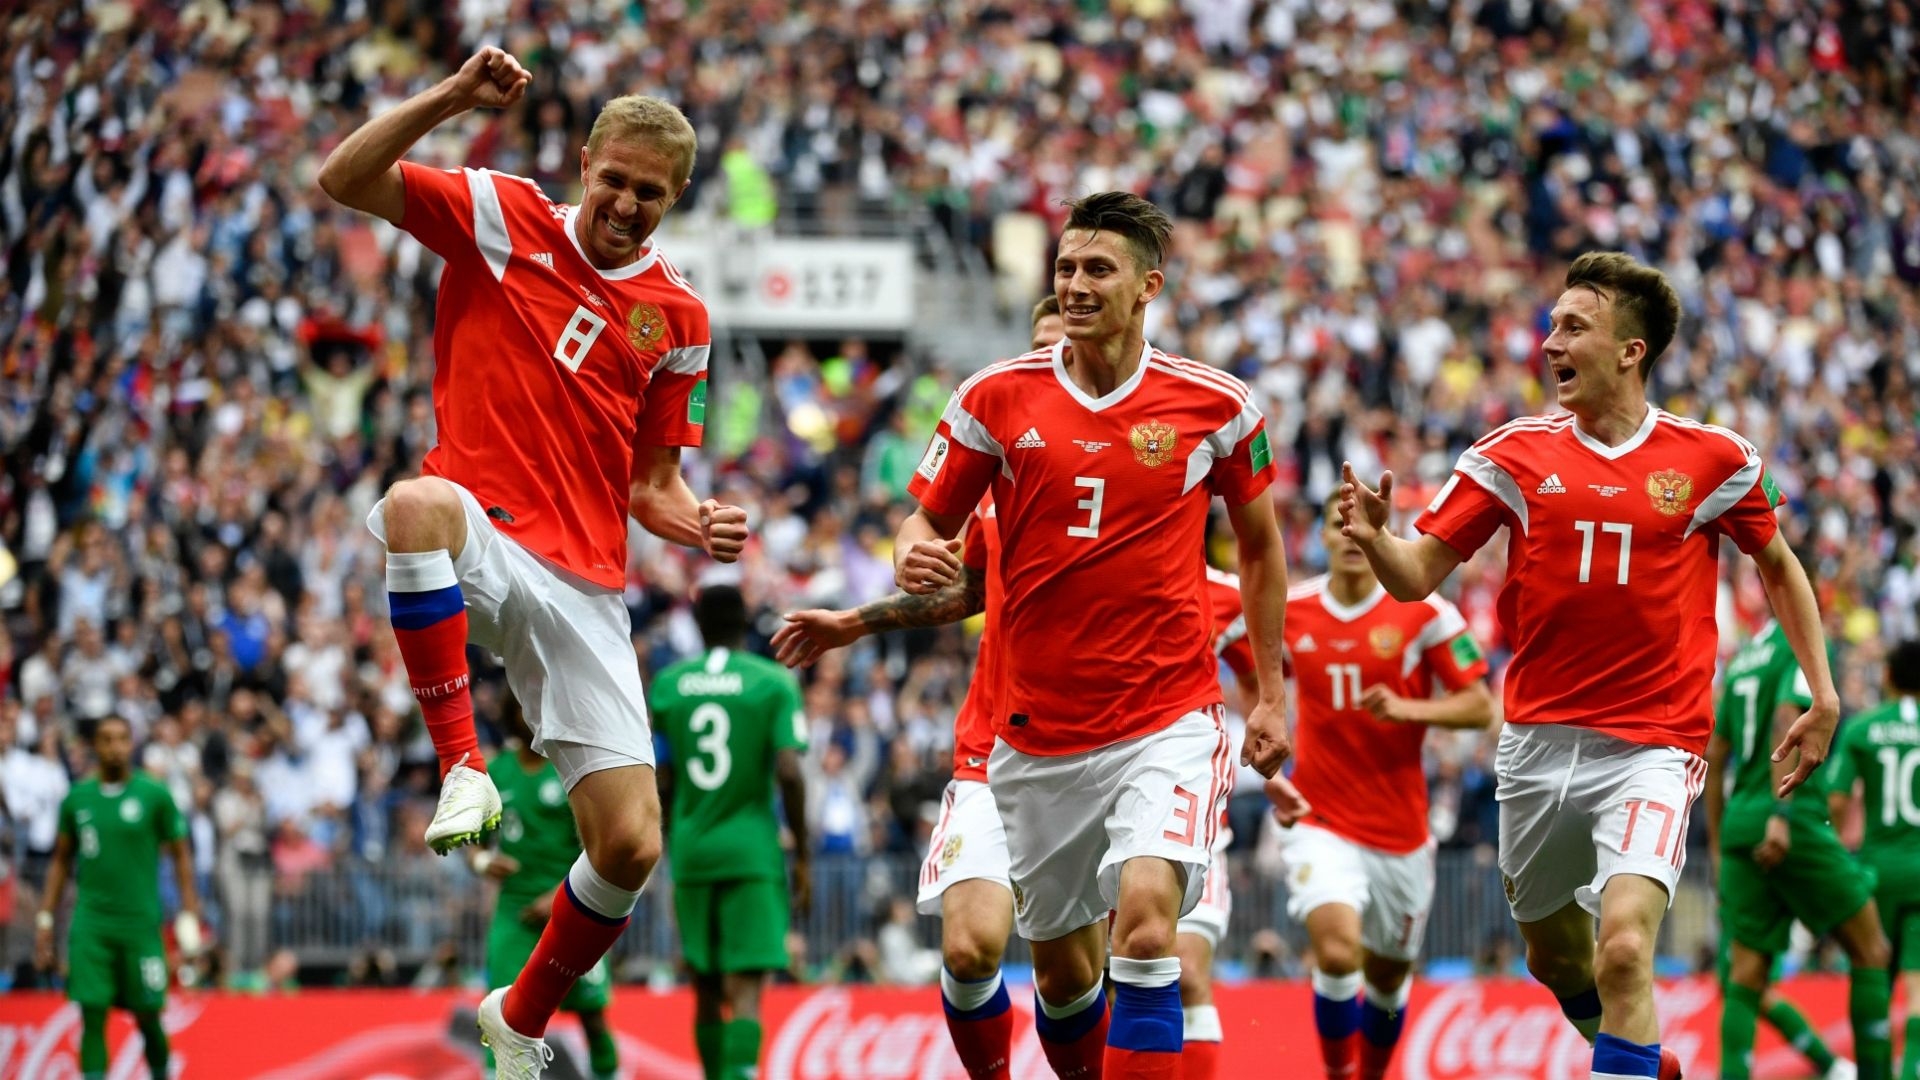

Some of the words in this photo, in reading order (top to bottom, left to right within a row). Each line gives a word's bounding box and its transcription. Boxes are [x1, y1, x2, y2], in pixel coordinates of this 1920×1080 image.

[553, 304, 607, 374] 8
[1067, 476, 1105, 539] 3
[1574, 520, 1633, 585] 17
[1325, 663, 1362, 711] 11
[686, 702, 732, 791] 3
[1163, 784, 1199, 847] 3
[1877, 747, 1920, 827] 10
[1620, 800, 1676, 858] 17
